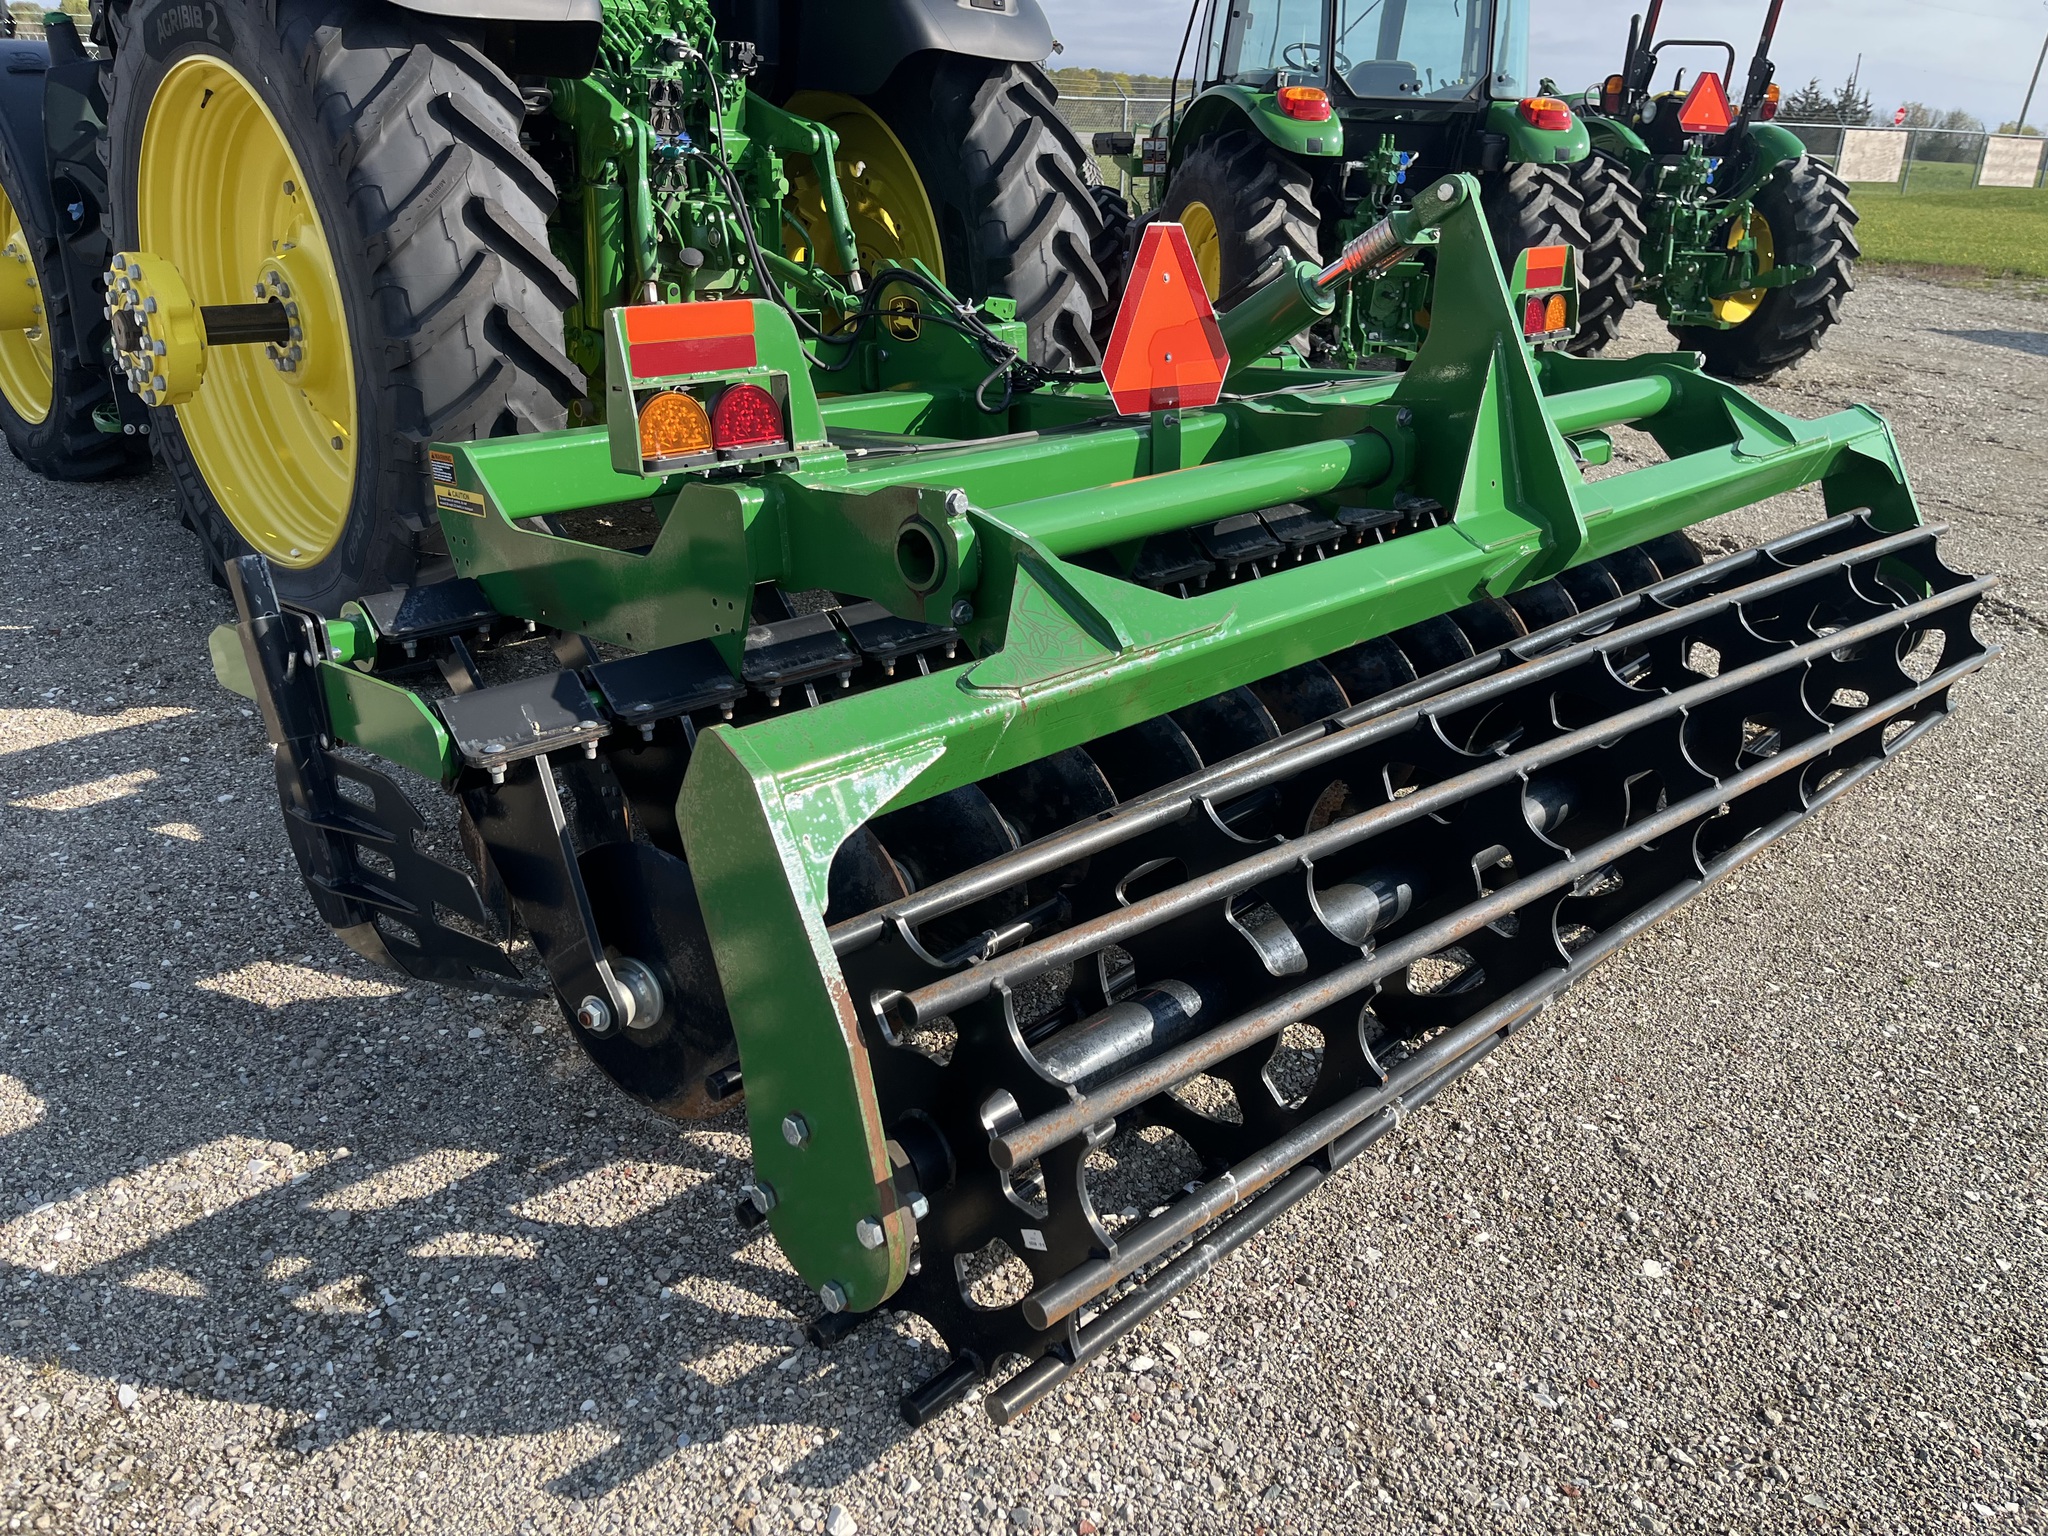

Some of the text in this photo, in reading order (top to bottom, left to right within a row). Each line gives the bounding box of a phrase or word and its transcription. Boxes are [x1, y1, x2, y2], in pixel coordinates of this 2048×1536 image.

[157, 1, 220, 45] AGRIBIB 2
[452, 490, 470, 500] CAUTION
